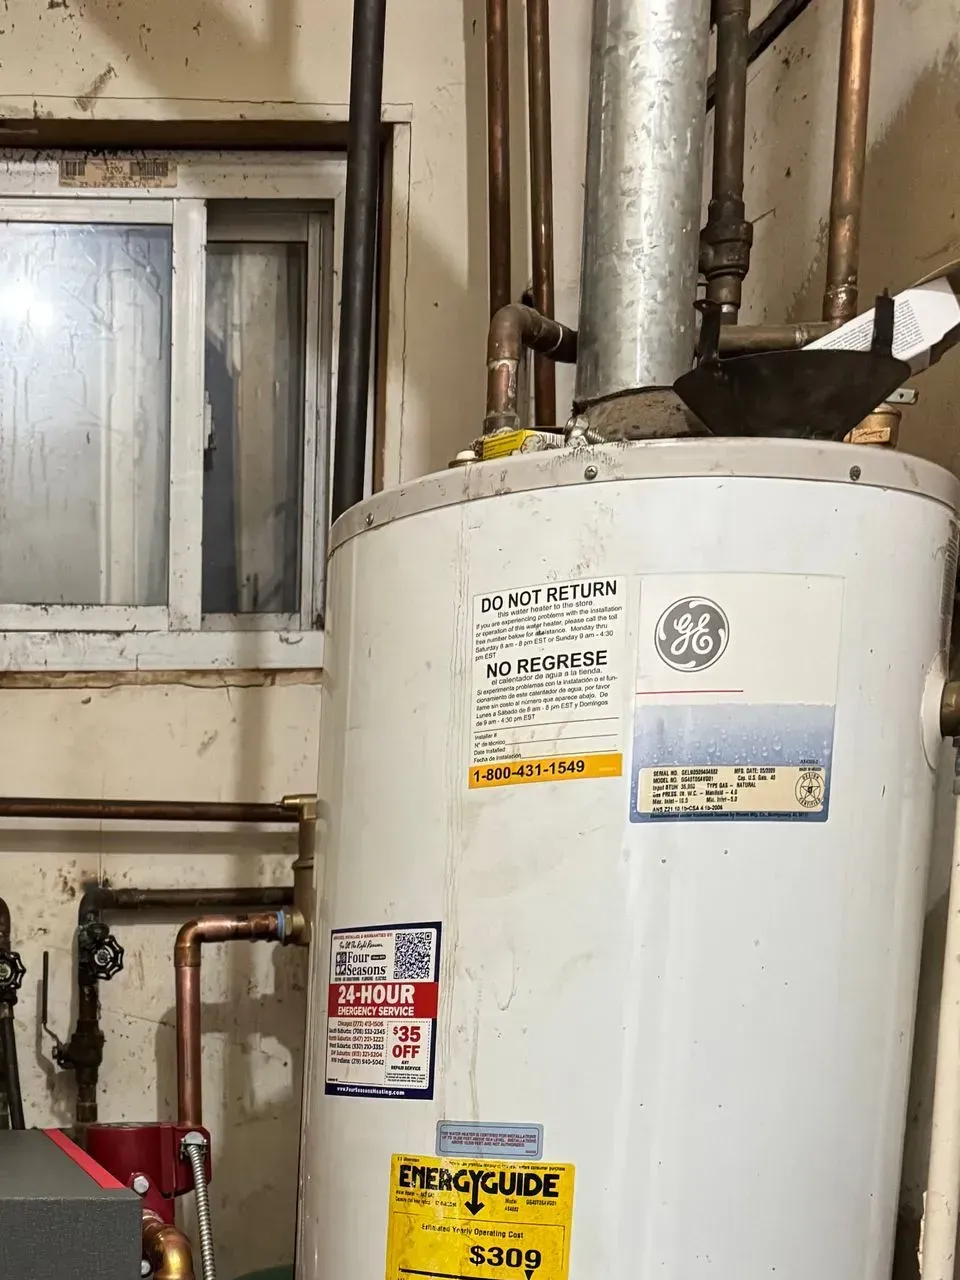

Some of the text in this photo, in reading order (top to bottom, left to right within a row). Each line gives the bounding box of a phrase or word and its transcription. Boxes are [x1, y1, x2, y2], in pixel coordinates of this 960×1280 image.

[481, 580, 617, 613] DO NOT RETURN
[531, 605, 552, 613] heater
[501, 615, 536, 626] experiencing
[538, 612, 564, 621] problems
[482, 628, 507, 637] operation
[476, 645, 498, 654] Saturday
[556, 633, 578, 641] Sunday
[487, 650, 608, 678] NO REGRESE
[499, 675, 533, 685] calentador
[546, 671, 562, 680] agua
[474, 760, 584, 782] 1-800-431-1549
[347, 952, 370, 963] Four
[347, 965, 386, 976] Seasons
[338, 984, 415, 1004] 24-HOUR
[338, 1006, 414, 1016] EMERGENCY SERVICE
[393, 1026, 420, 1042] $35
[392, 1045, 420, 1058] OFF
[399, 1164, 560, 1198] ENERGYGUIDE
[474, 1228, 506, 1239] Operating
[469, 1245, 542, 1269] $309
